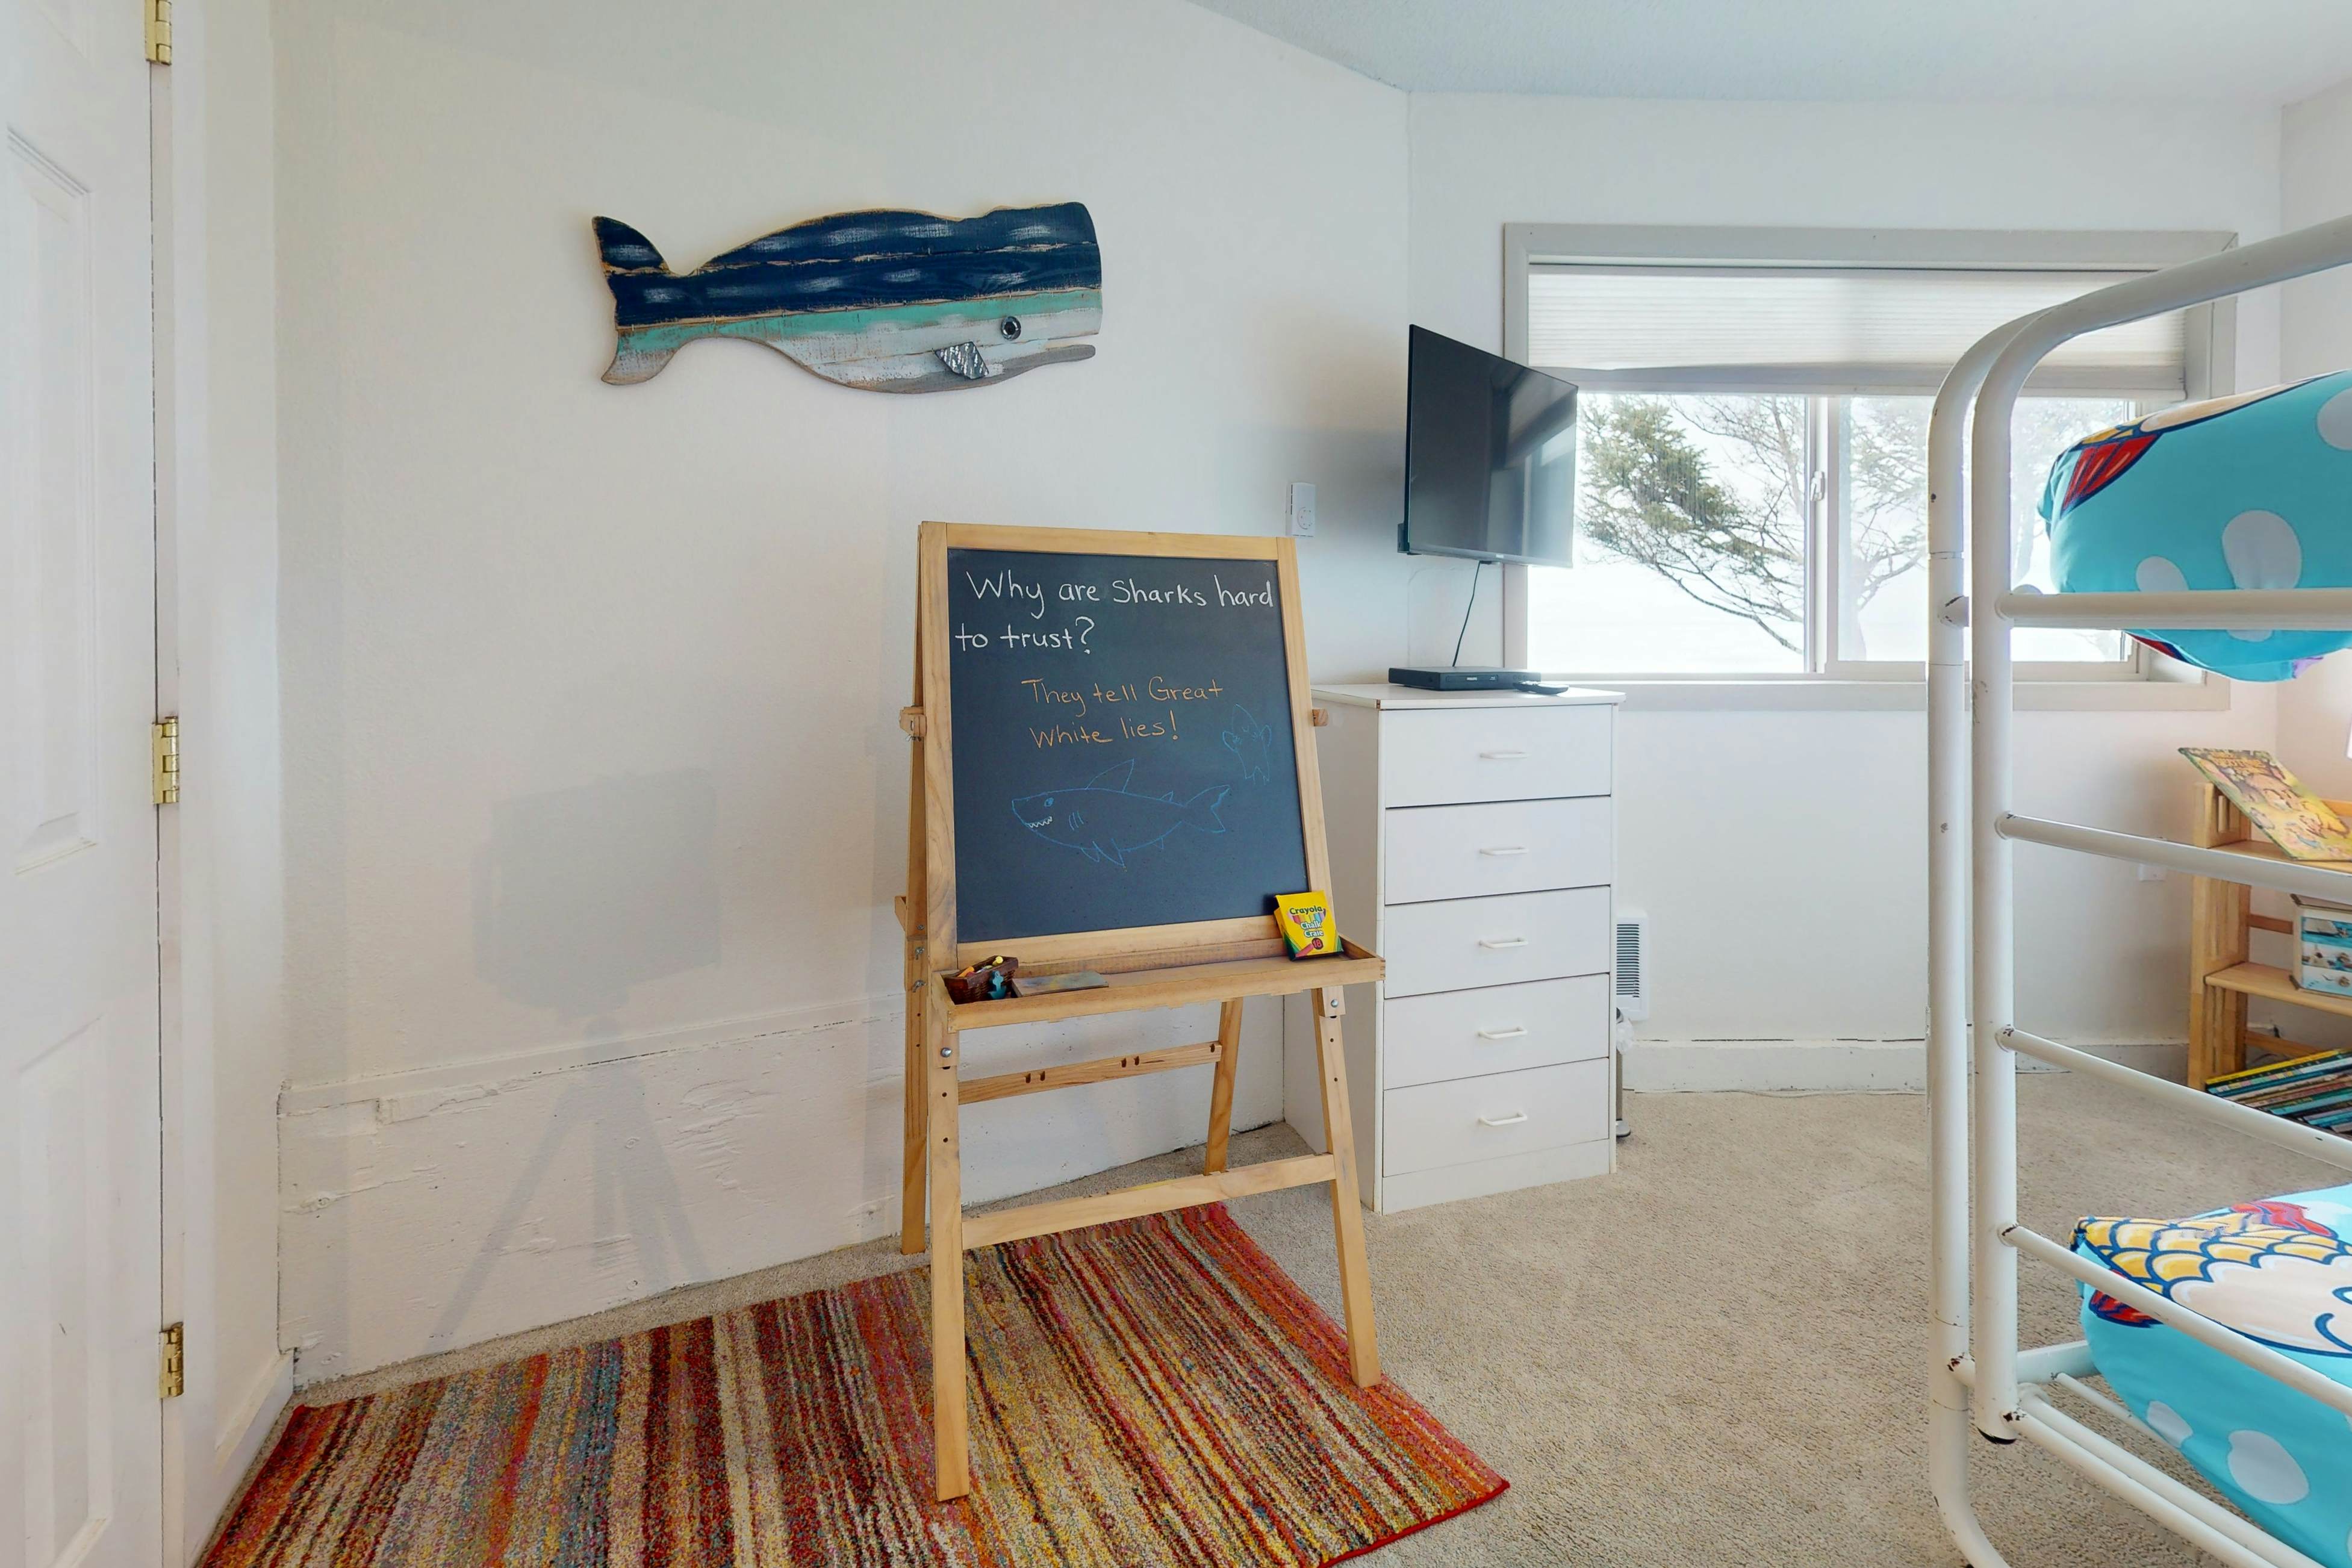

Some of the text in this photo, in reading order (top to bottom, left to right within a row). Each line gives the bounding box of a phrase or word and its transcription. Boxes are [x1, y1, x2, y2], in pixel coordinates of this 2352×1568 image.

[966, 569, 1274, 620] Why are Sharks hard
[954, 615, 1095, 655] to trust?
[1021, 675, 1224, 718] They tell Great
[1029, 709, 1179, 749] White lies!
[1289, 906, 1323, 915] Crayola
[1301, 921, 1322, 929] Chalk
